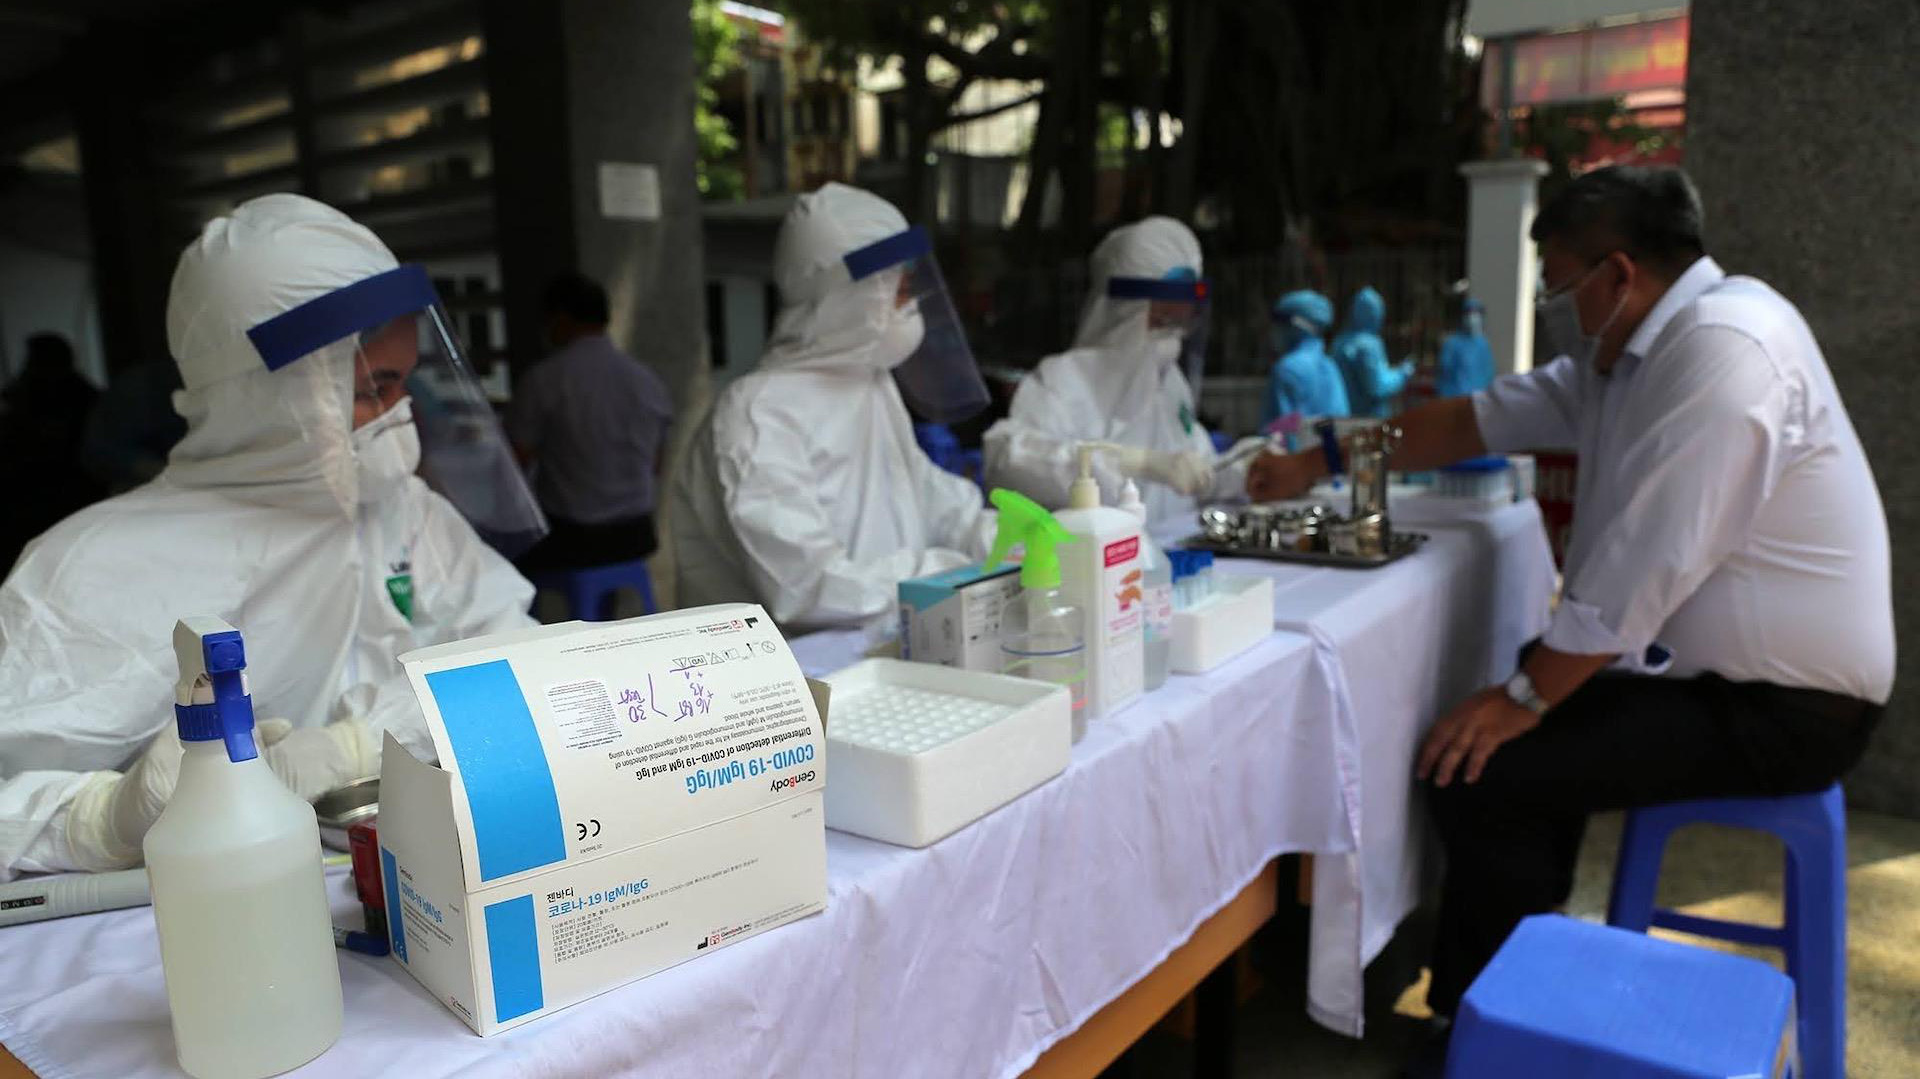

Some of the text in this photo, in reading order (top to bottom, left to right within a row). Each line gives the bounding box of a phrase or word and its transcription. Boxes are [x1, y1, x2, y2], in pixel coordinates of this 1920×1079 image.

[629, 705, 646, 722] 30
[772, 727, 811, 742] Differential
[626, 744, 653, 756] COVID-19
[654, 740, 674, 748] against
[680, 744, 690, 752] and
[690, 742, 704, 750] rapid
[737, 737, 770, 752] detection
[609, 749, 625, 760] using
[649, 748, 679, 760] differential
[727, 747, 734, 755] of
[623, 755, 648, 766] detection
[669, 759, 685, 772] IgM
[636, 768, 650, 780] IgG
[652, 764, 668, 774] and
[686, 744, 814, 794] COVID-19 IgM/IgG
[770, 771, 815, 792] GenBody
[547, 887, 574, 903] 젠바디
[548, 893, 602, 918] 코로나-19
[604, 879, 648, 902] IgM/IgG
